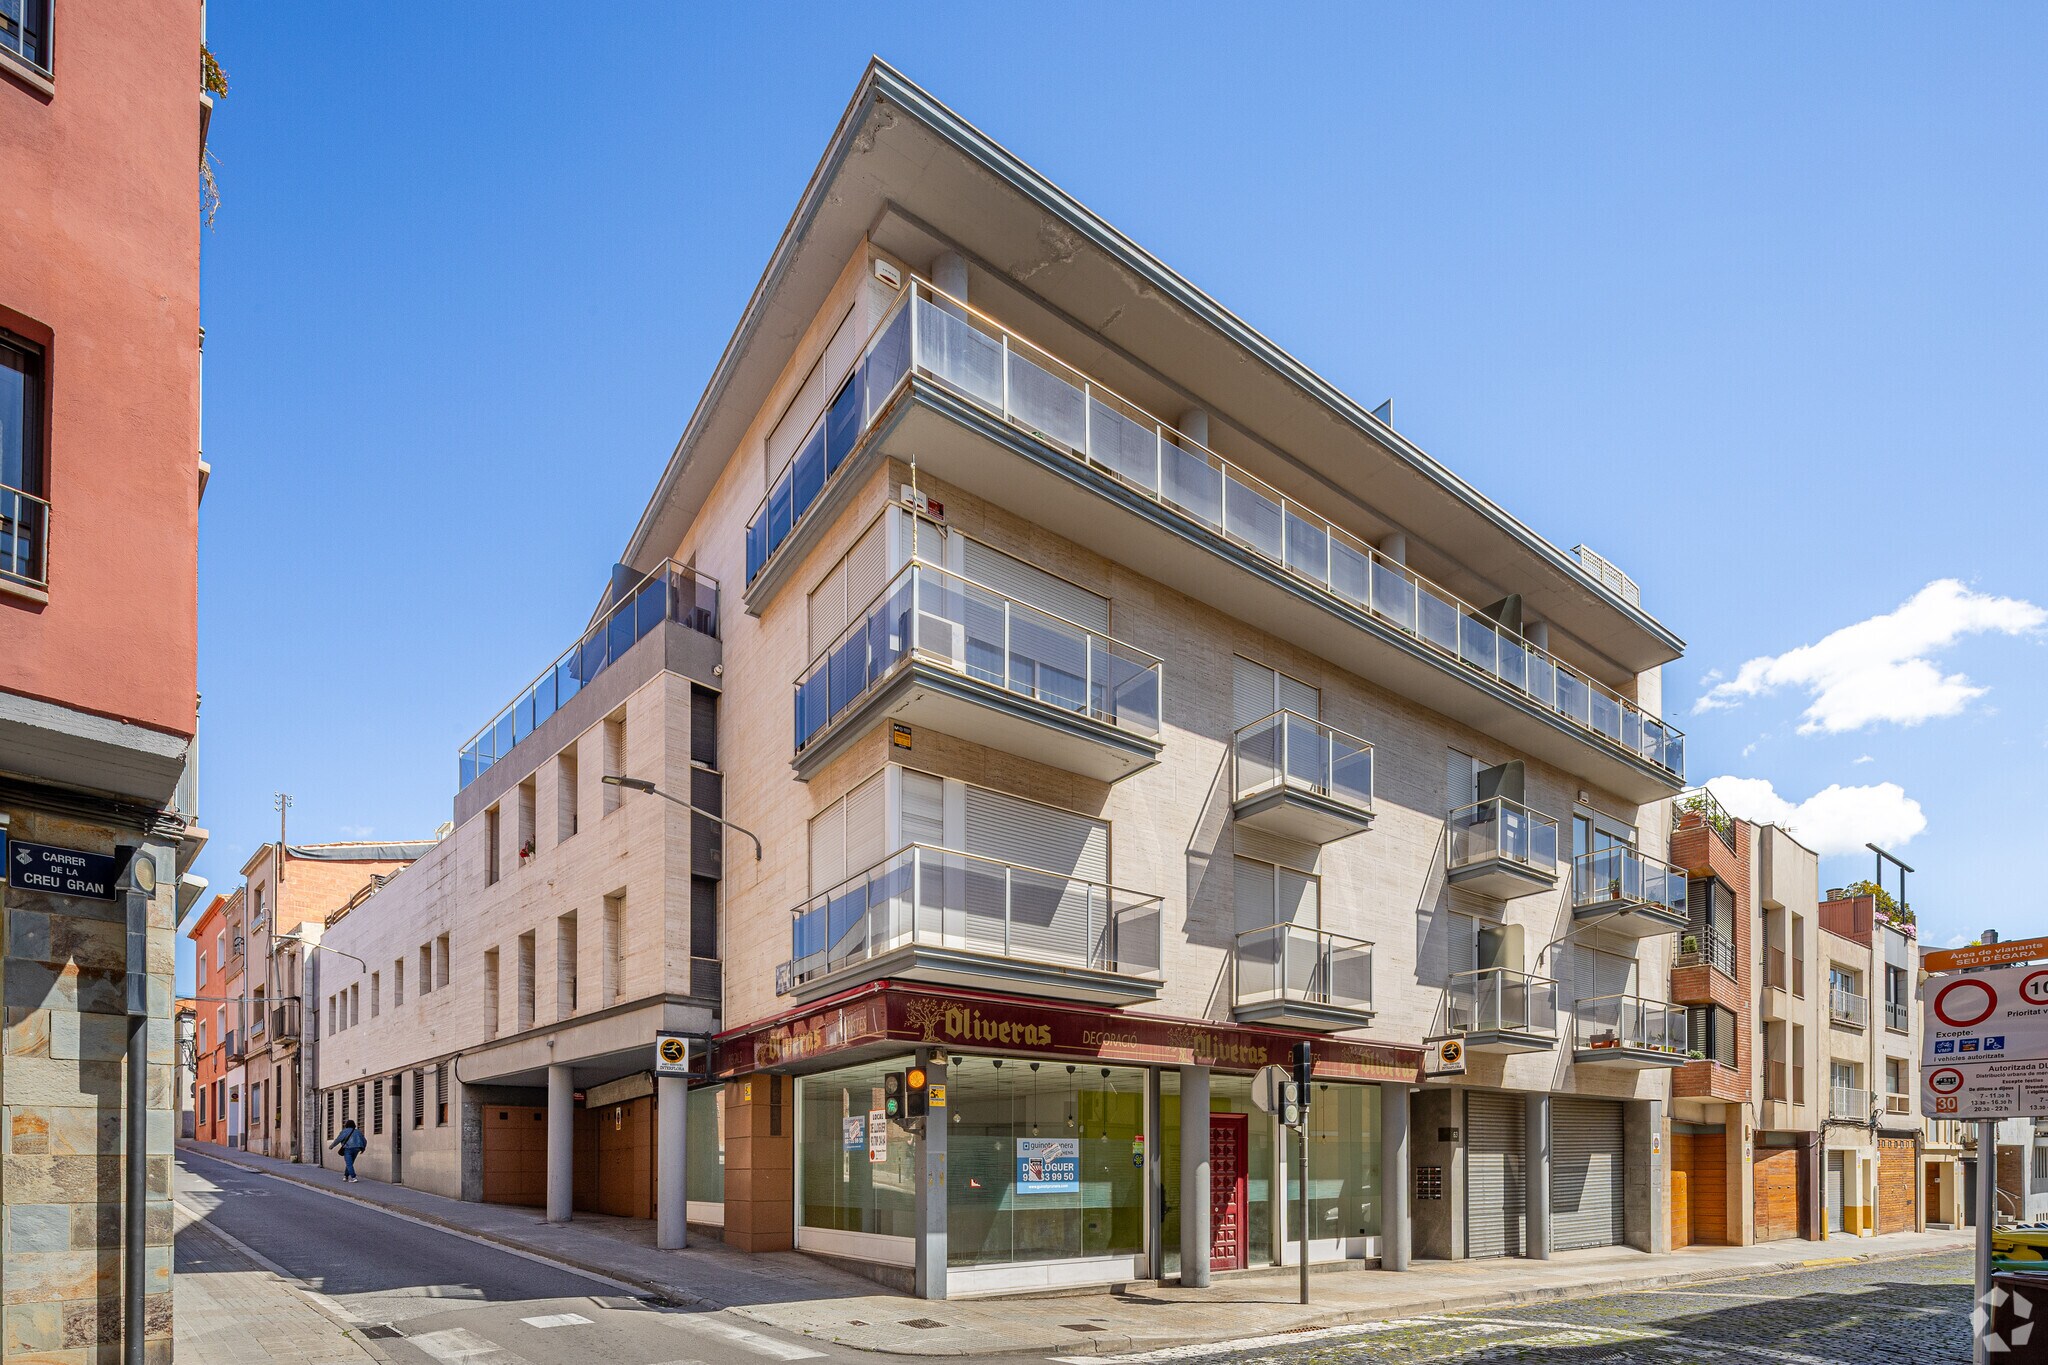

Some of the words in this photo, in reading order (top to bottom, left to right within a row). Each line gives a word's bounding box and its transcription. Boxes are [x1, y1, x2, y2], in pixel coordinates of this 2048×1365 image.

[42, 852, 86, 866] CARRER
[51, 866, 62, 874] DE
[66, 868, 78, 876] LA
[24, 872, 60, 888] CREU
[66, 879, 104, 894] GRAN
[1995, 943, 2043, 954] vianants
[2007, 1009, 2041, 1017] Prioritat
[944, 1006, 1052, 1046] Oliveras
[1082, 1030, 1138, 1048] DECORACIÓ
[1936, 1030, 1974, 1038] Excepte:
[1986, 1038, 1995, 1046] P
[1193, 1034, 1268, 1064] Oliveras
[1362, 1052, 1417, 1078] Oliveras
[1937, 1097, 1957, 1110] 30
[1064, 1172, 1074, 1180] 50
